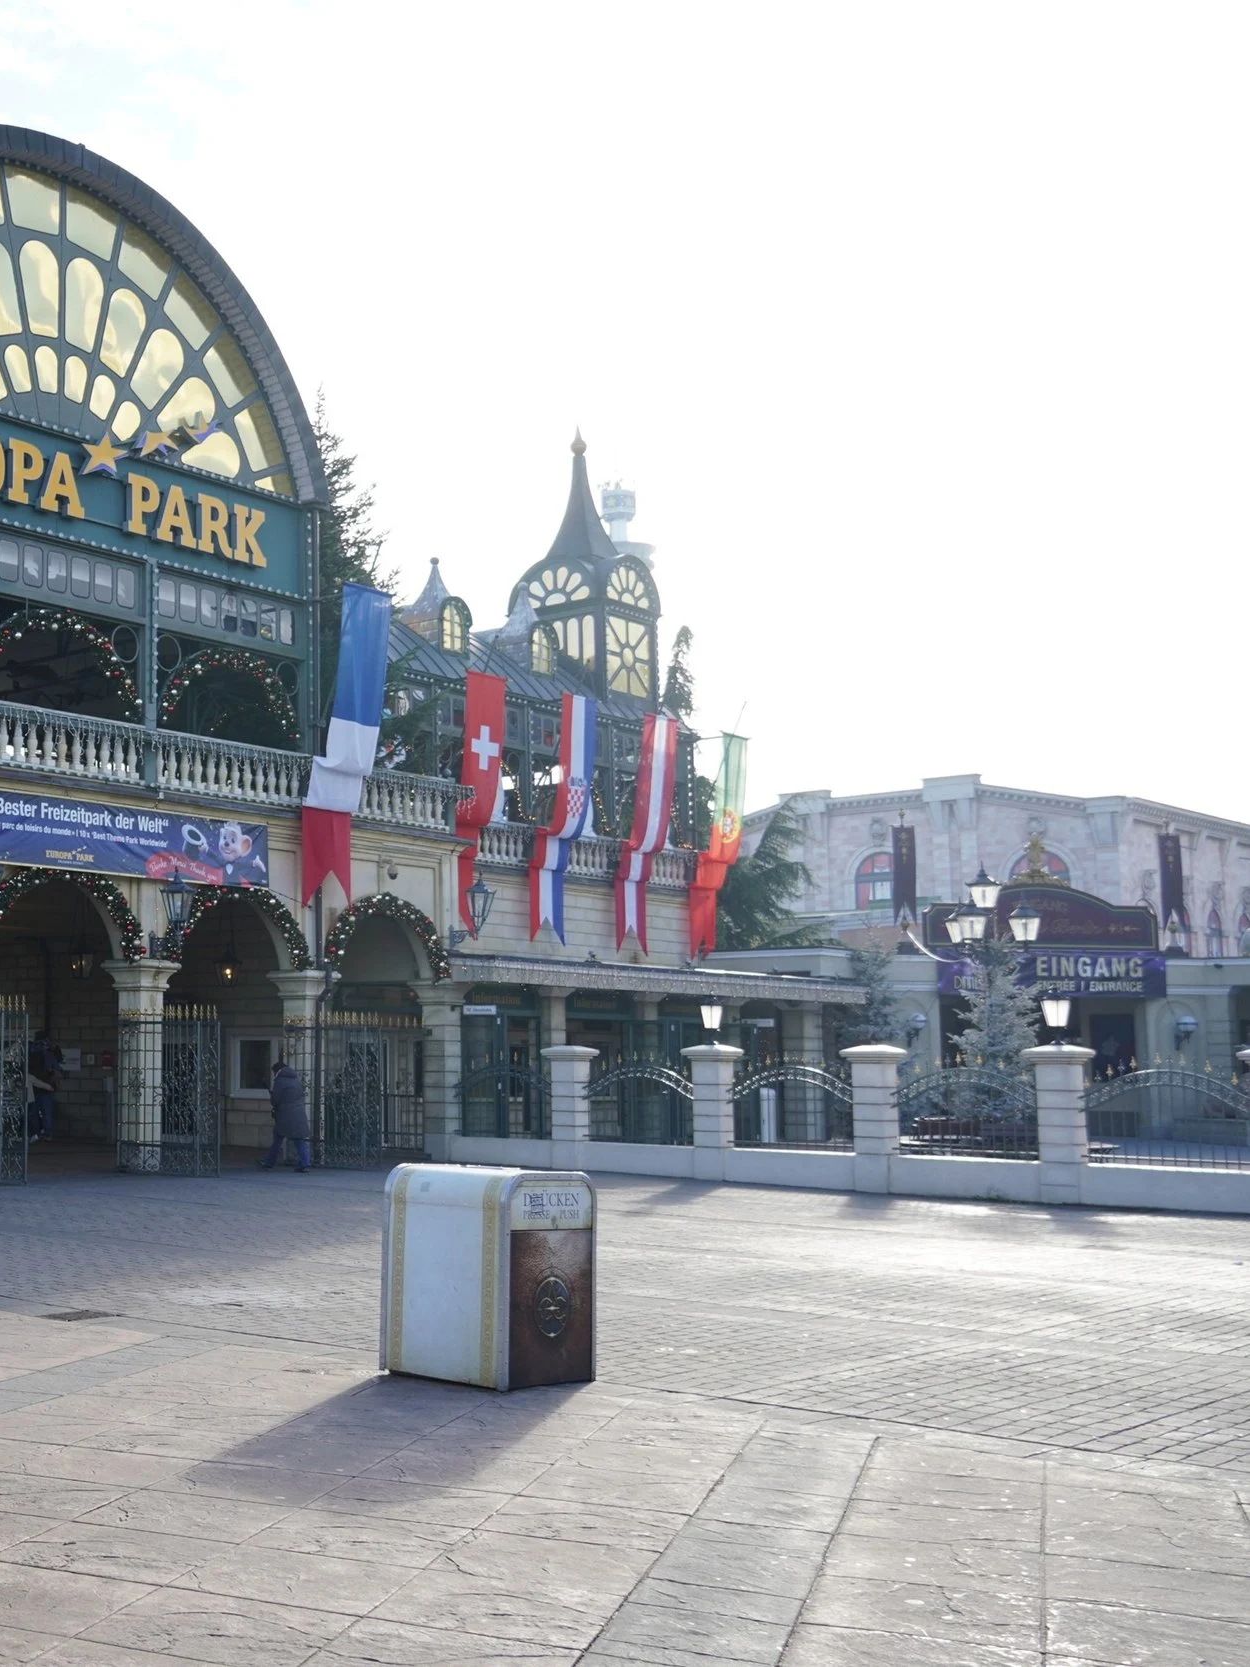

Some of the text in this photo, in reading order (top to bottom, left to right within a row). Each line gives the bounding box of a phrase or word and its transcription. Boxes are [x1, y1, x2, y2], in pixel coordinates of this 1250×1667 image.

[123, 472, 266, 568] PARK
[41, 802, 112, 828] Freizeitpark
[115, 813, 135, 830] der
[2, 822, 15, 831] parc
[16, 823, 23, 831] de
[24, 823, 43, 833] loisirs
[44, 826, 51, 834] du
[52, 828, 71, 836] monde
[106, 833, 125, 843] Theme
[126, 836, 138, 845] Park
[45, 850, 73, 860] EUROPA
[76, 853, 94, 863] PARK
[170, 855, 187, 869] Merci
[190, 862, 207, 877] Thank
[206, 873, 217, 882] you
[1036, 957, 1144, 978] EINGANG
[1037, 979, 1076, 992] ENTRÉE
[1089, 981, 1143, 993] ENTRANCE
[559, 1209, 579, 1220] PUSH
